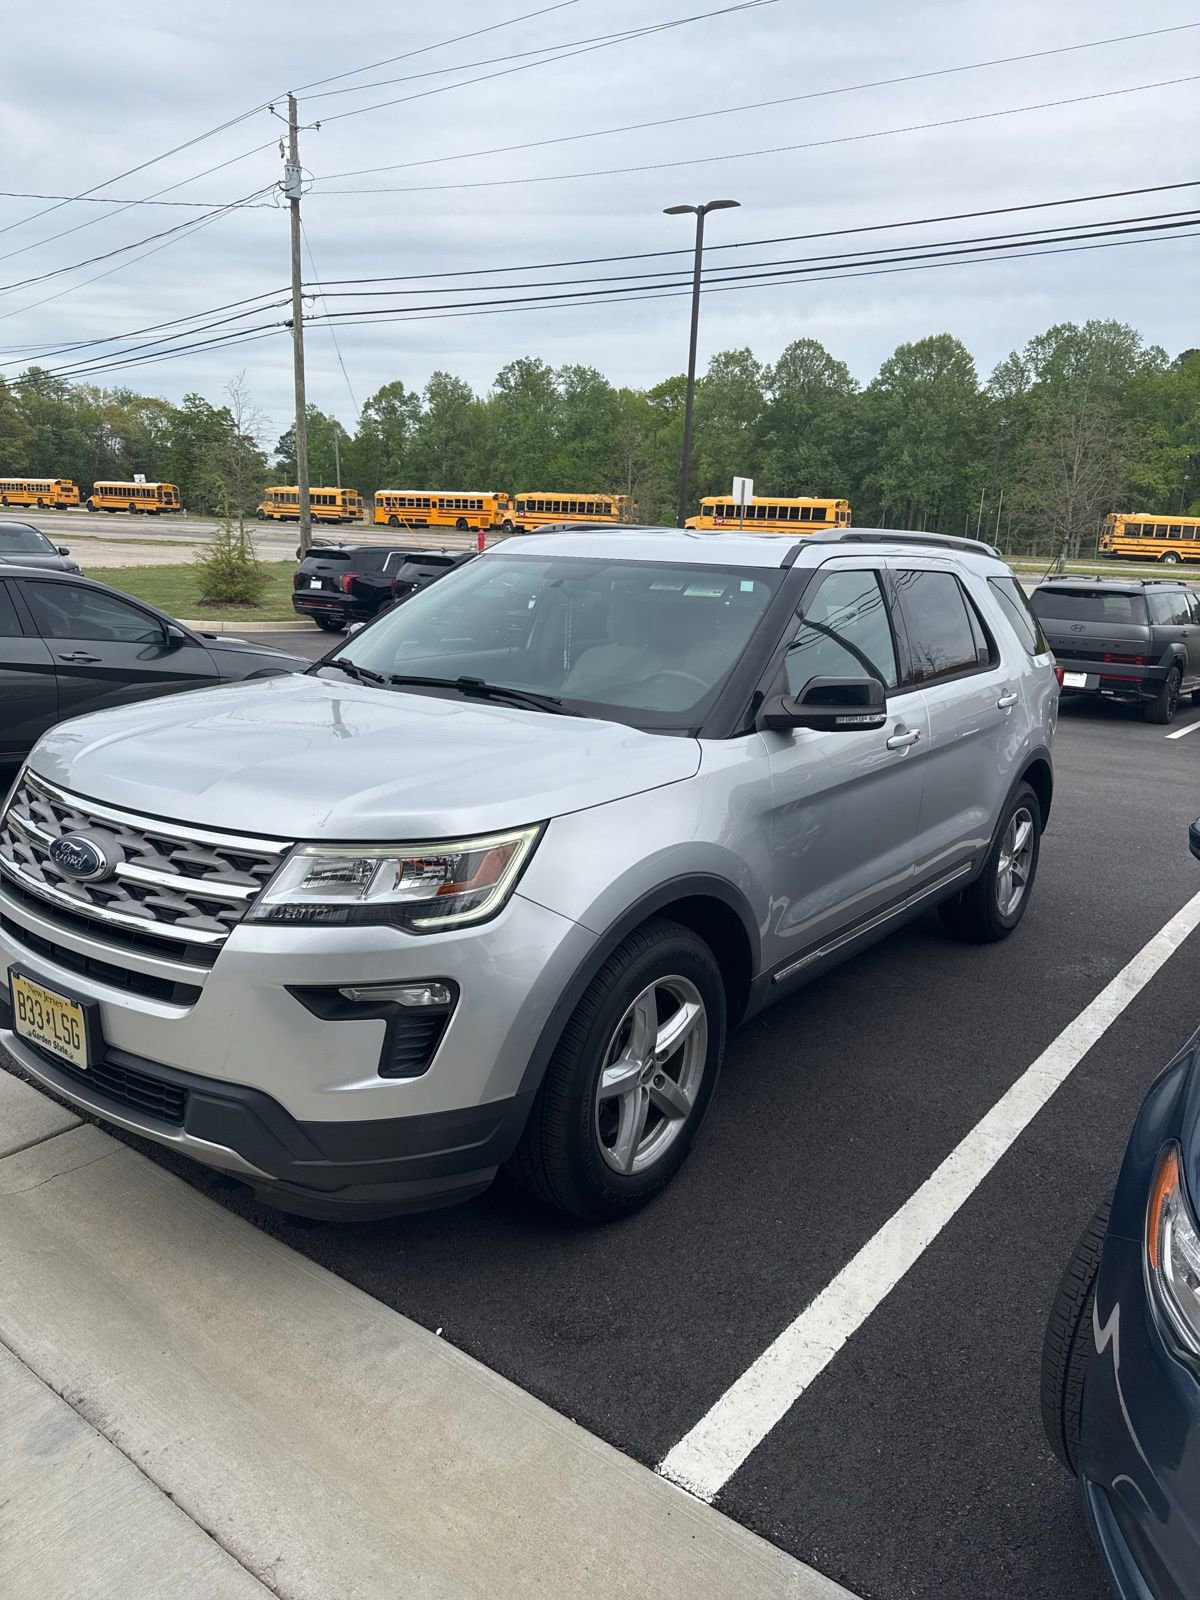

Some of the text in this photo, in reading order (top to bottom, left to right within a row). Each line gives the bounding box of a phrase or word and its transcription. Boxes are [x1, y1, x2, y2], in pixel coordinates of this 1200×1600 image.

[55, 840, 88, 870] Ford
[27, 983, 64, 1011] New Jersey
[32, 1029, 69, 1056] Garden State
